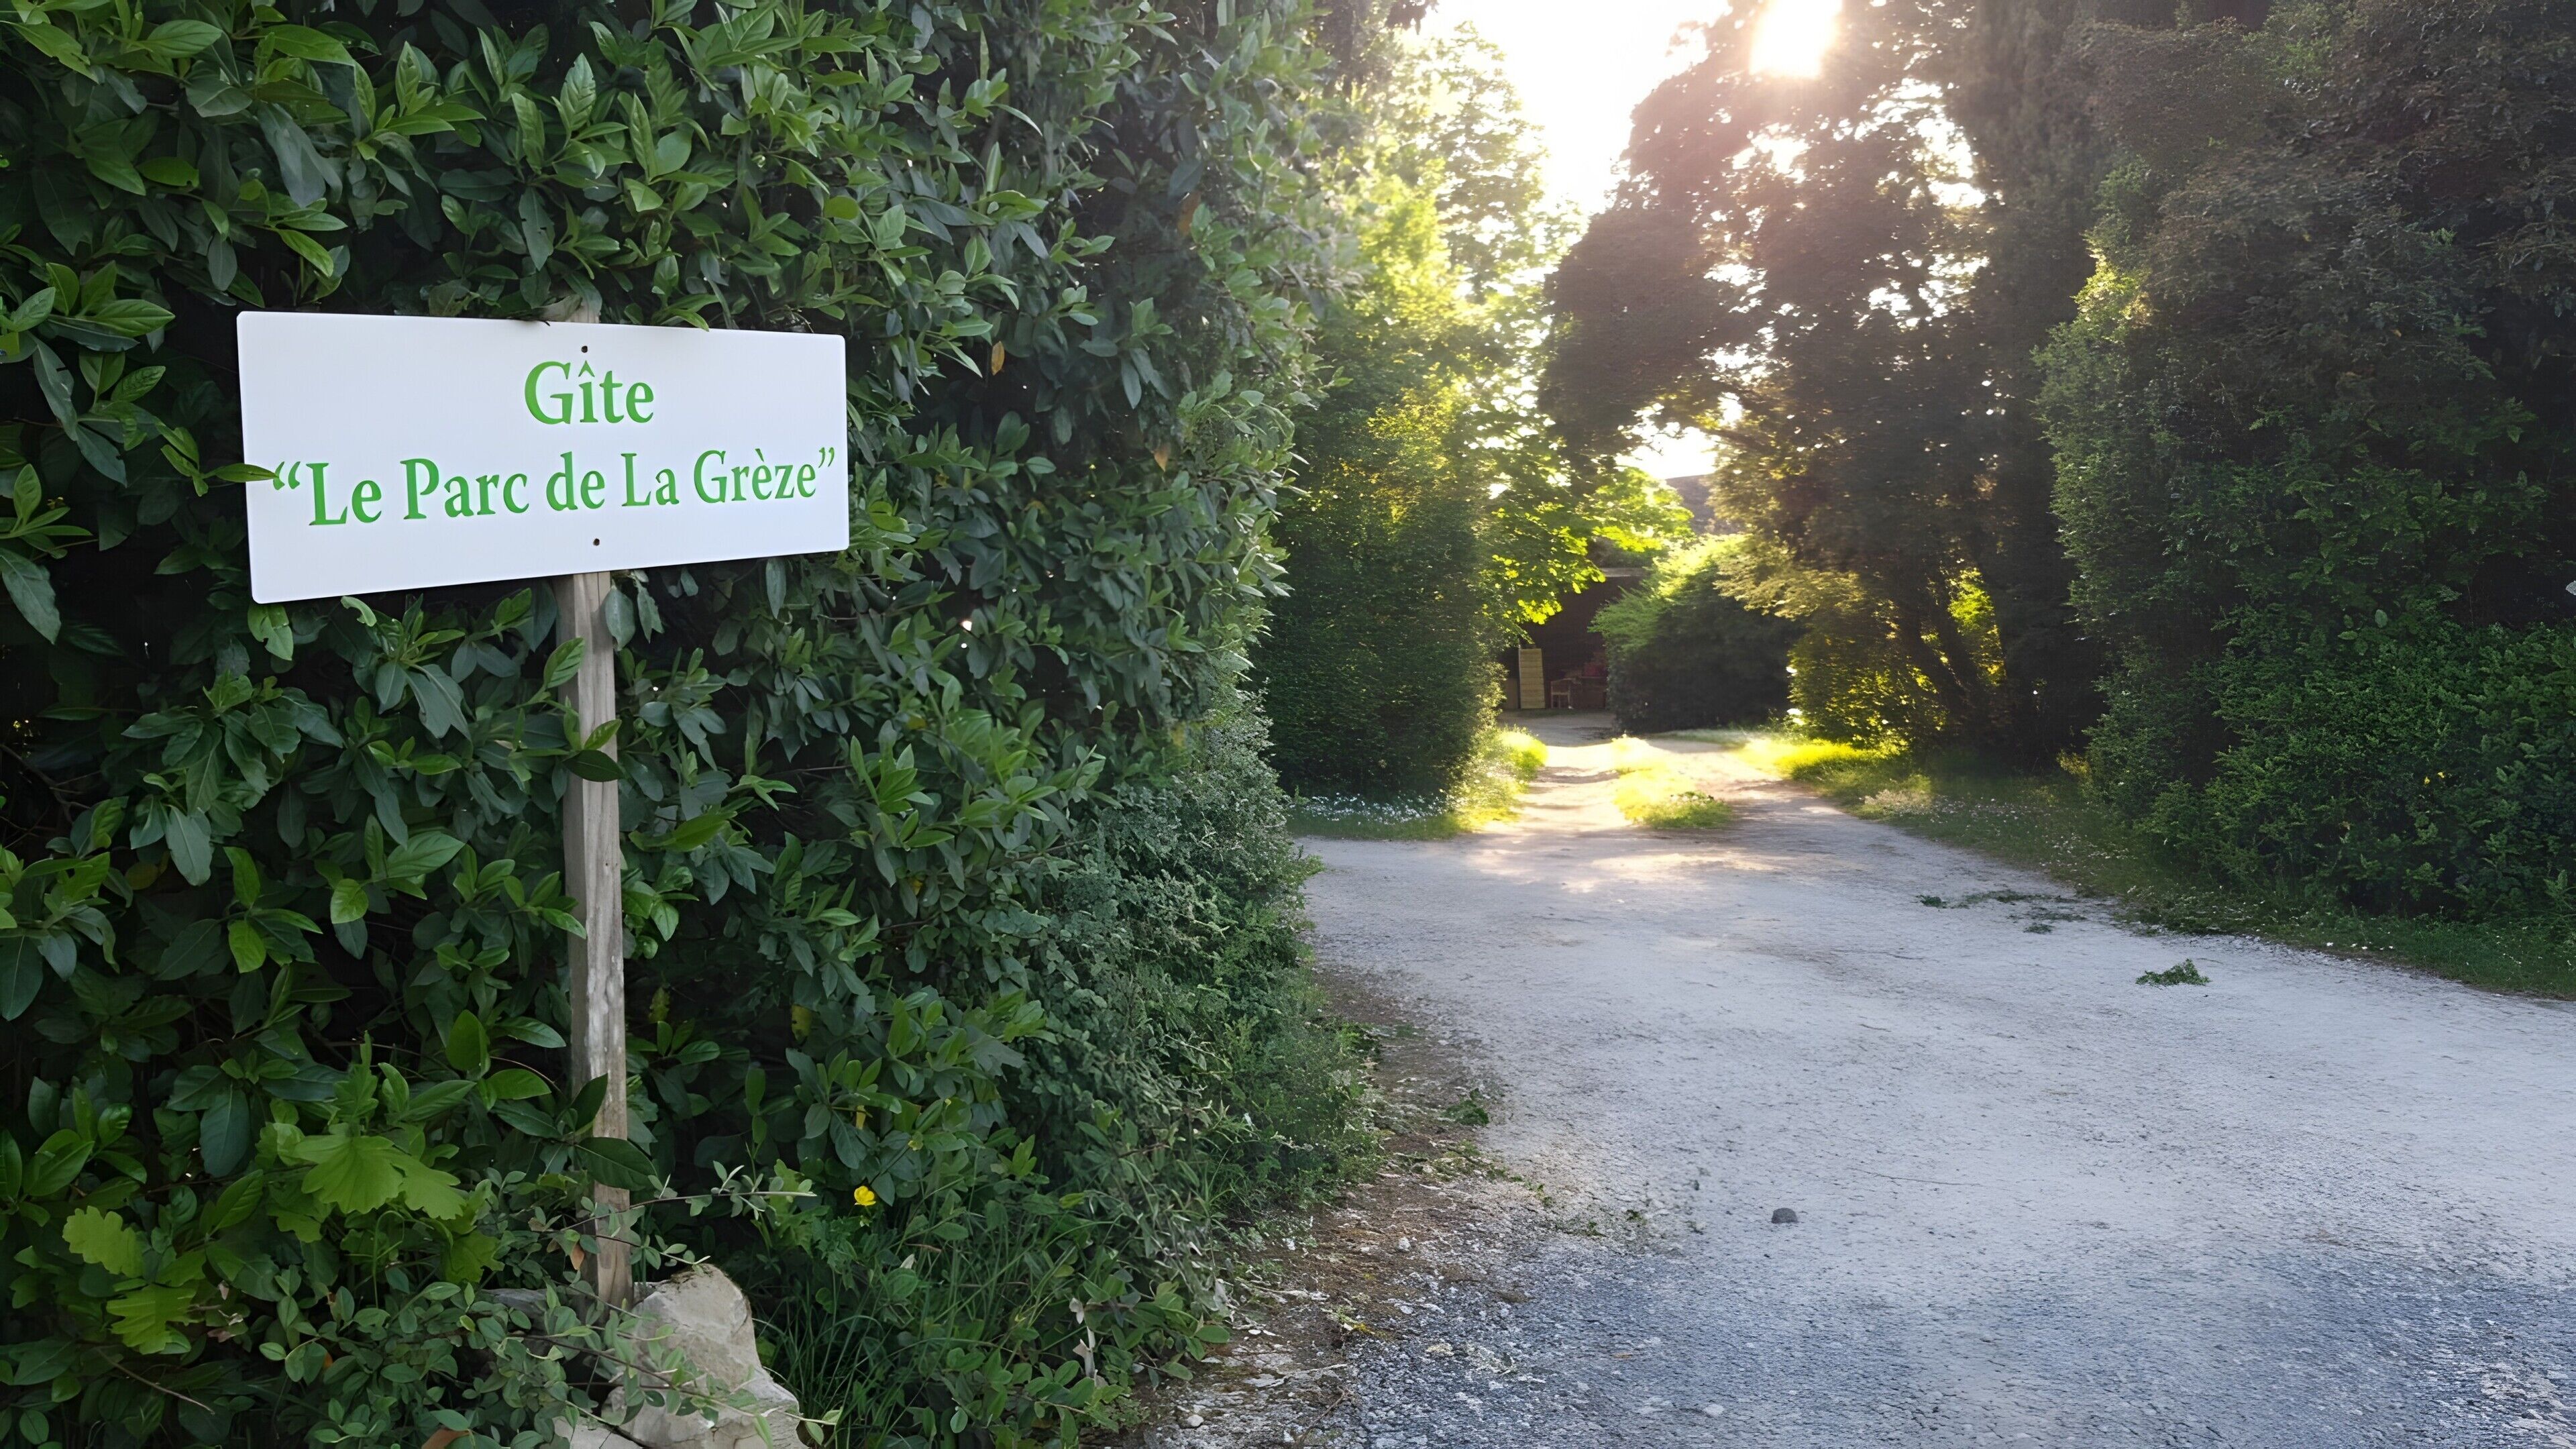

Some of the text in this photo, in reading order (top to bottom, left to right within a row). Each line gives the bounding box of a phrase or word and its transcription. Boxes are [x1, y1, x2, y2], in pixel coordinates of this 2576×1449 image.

[524, 359, 656, 426] Gîte
[400, 457, 529, 521] Parc
[545, 449, 606, 512] de
[621, 451, 680, 508] La
